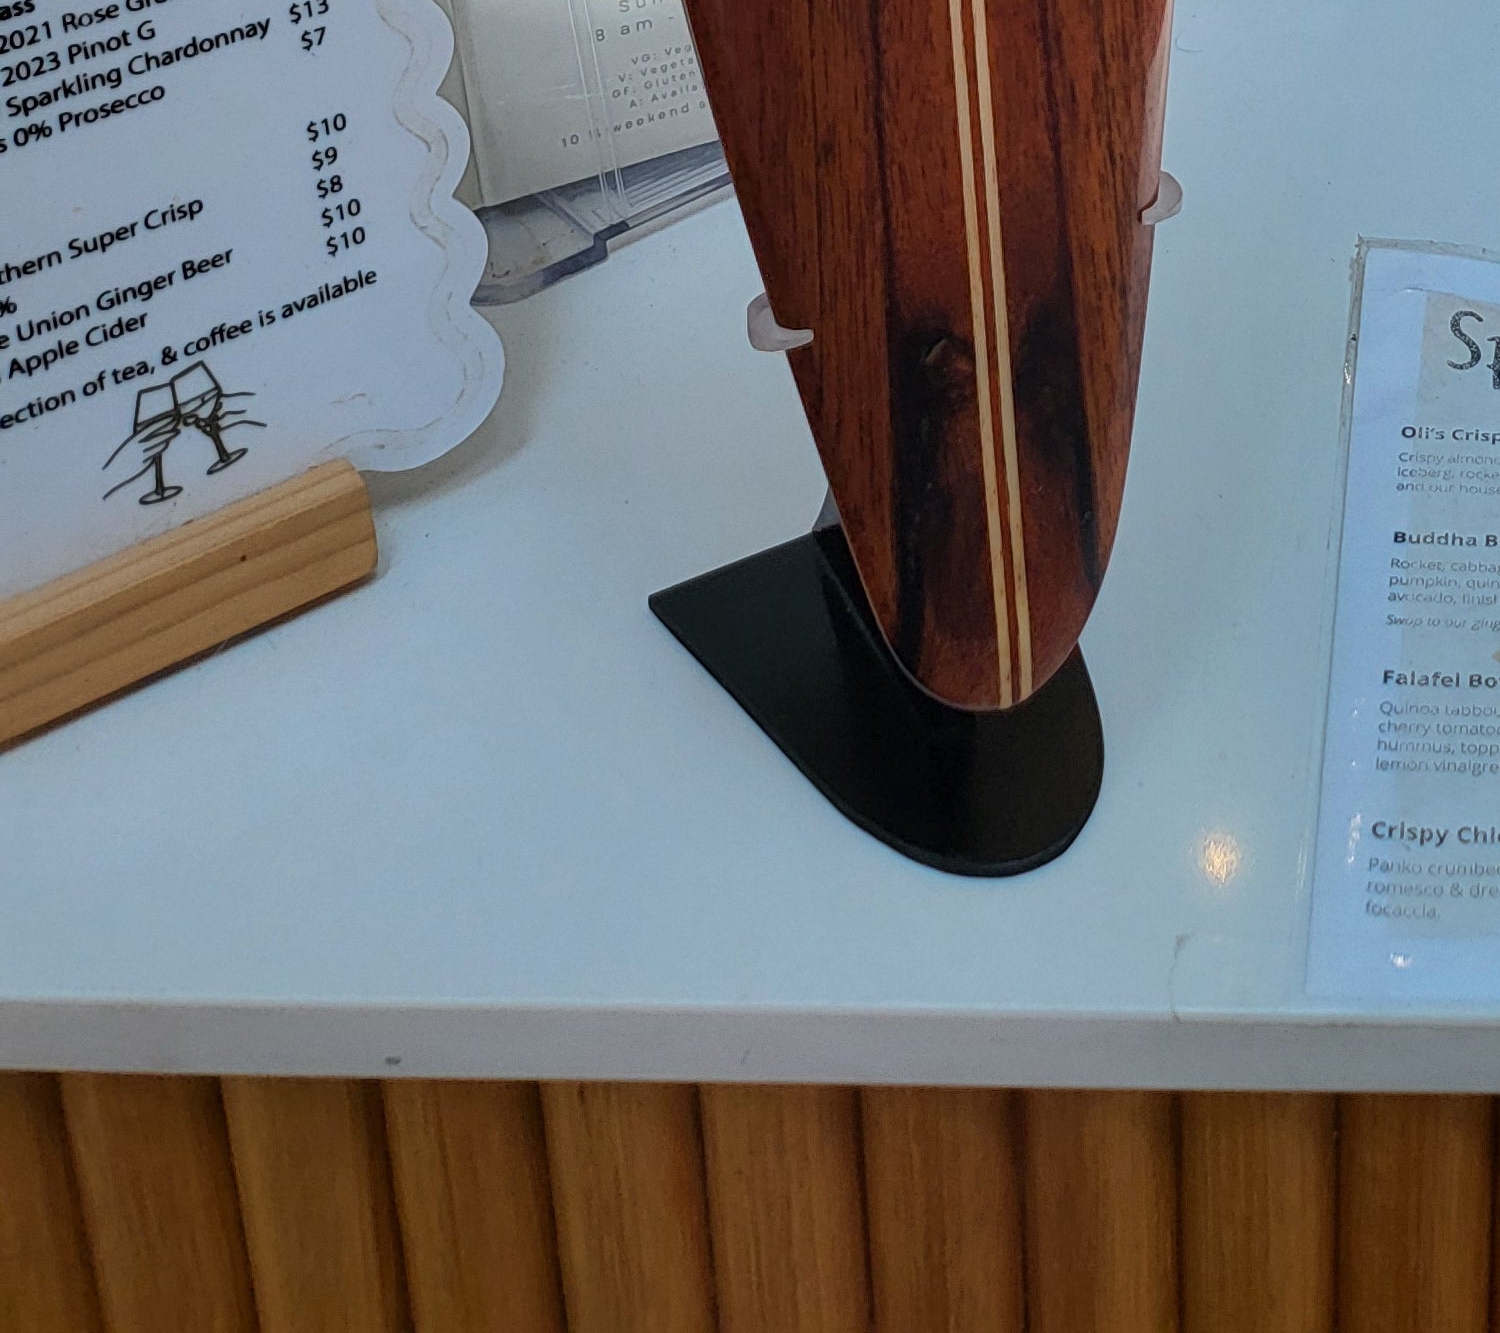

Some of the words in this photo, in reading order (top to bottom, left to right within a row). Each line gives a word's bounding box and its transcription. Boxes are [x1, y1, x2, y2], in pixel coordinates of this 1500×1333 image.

[0, 21, 53, 55] 2021
[62, 2, 120, 34] Rose
[301, 26, 326, 52] $7
[2, 51, 61, 88] 2023
[68, 29, 132, 65] Pinot
[137, 19, 157, 41] G
[6, 67, 123, 117] Sparkling
[128, 17, 272, 76] Chardonnay
[13, 118, 53, 147] 0%
[58, 85, 166, 133] Prosecco
[306, 113, 347, 143] $10
[311, 146, 338, 171] $9
[316, 175, 344, 200] $8
[321, 198, 362, 228] $10
[67, 220, 138, 260] Super
[144, 198, 204, 231] Crisp
[326, 227, 366, 257] $10
[16, 302, 90, 343] Union
[96, 270, 176, 312] Ginger
[181, 248, 234, 281] Beer
[8, 339, 80, 380] Apple
[85, 312, 148, 348] Cider
[83, 369, 107, 396] of
[112, 361, 156, 385] tea,
[161, 345, 178, 366] &
[183, 320, 253, 357] coffee
[259, 310, 276, 328] is
[281, 270, 378, 319] available
[1400, 425, 1446, 440] Oli's
[1392, 531, 1477, 547] Buddha
[1382, 669, 1460, 688] Falafel
[1371, 820, 1450, 847] Crispy
